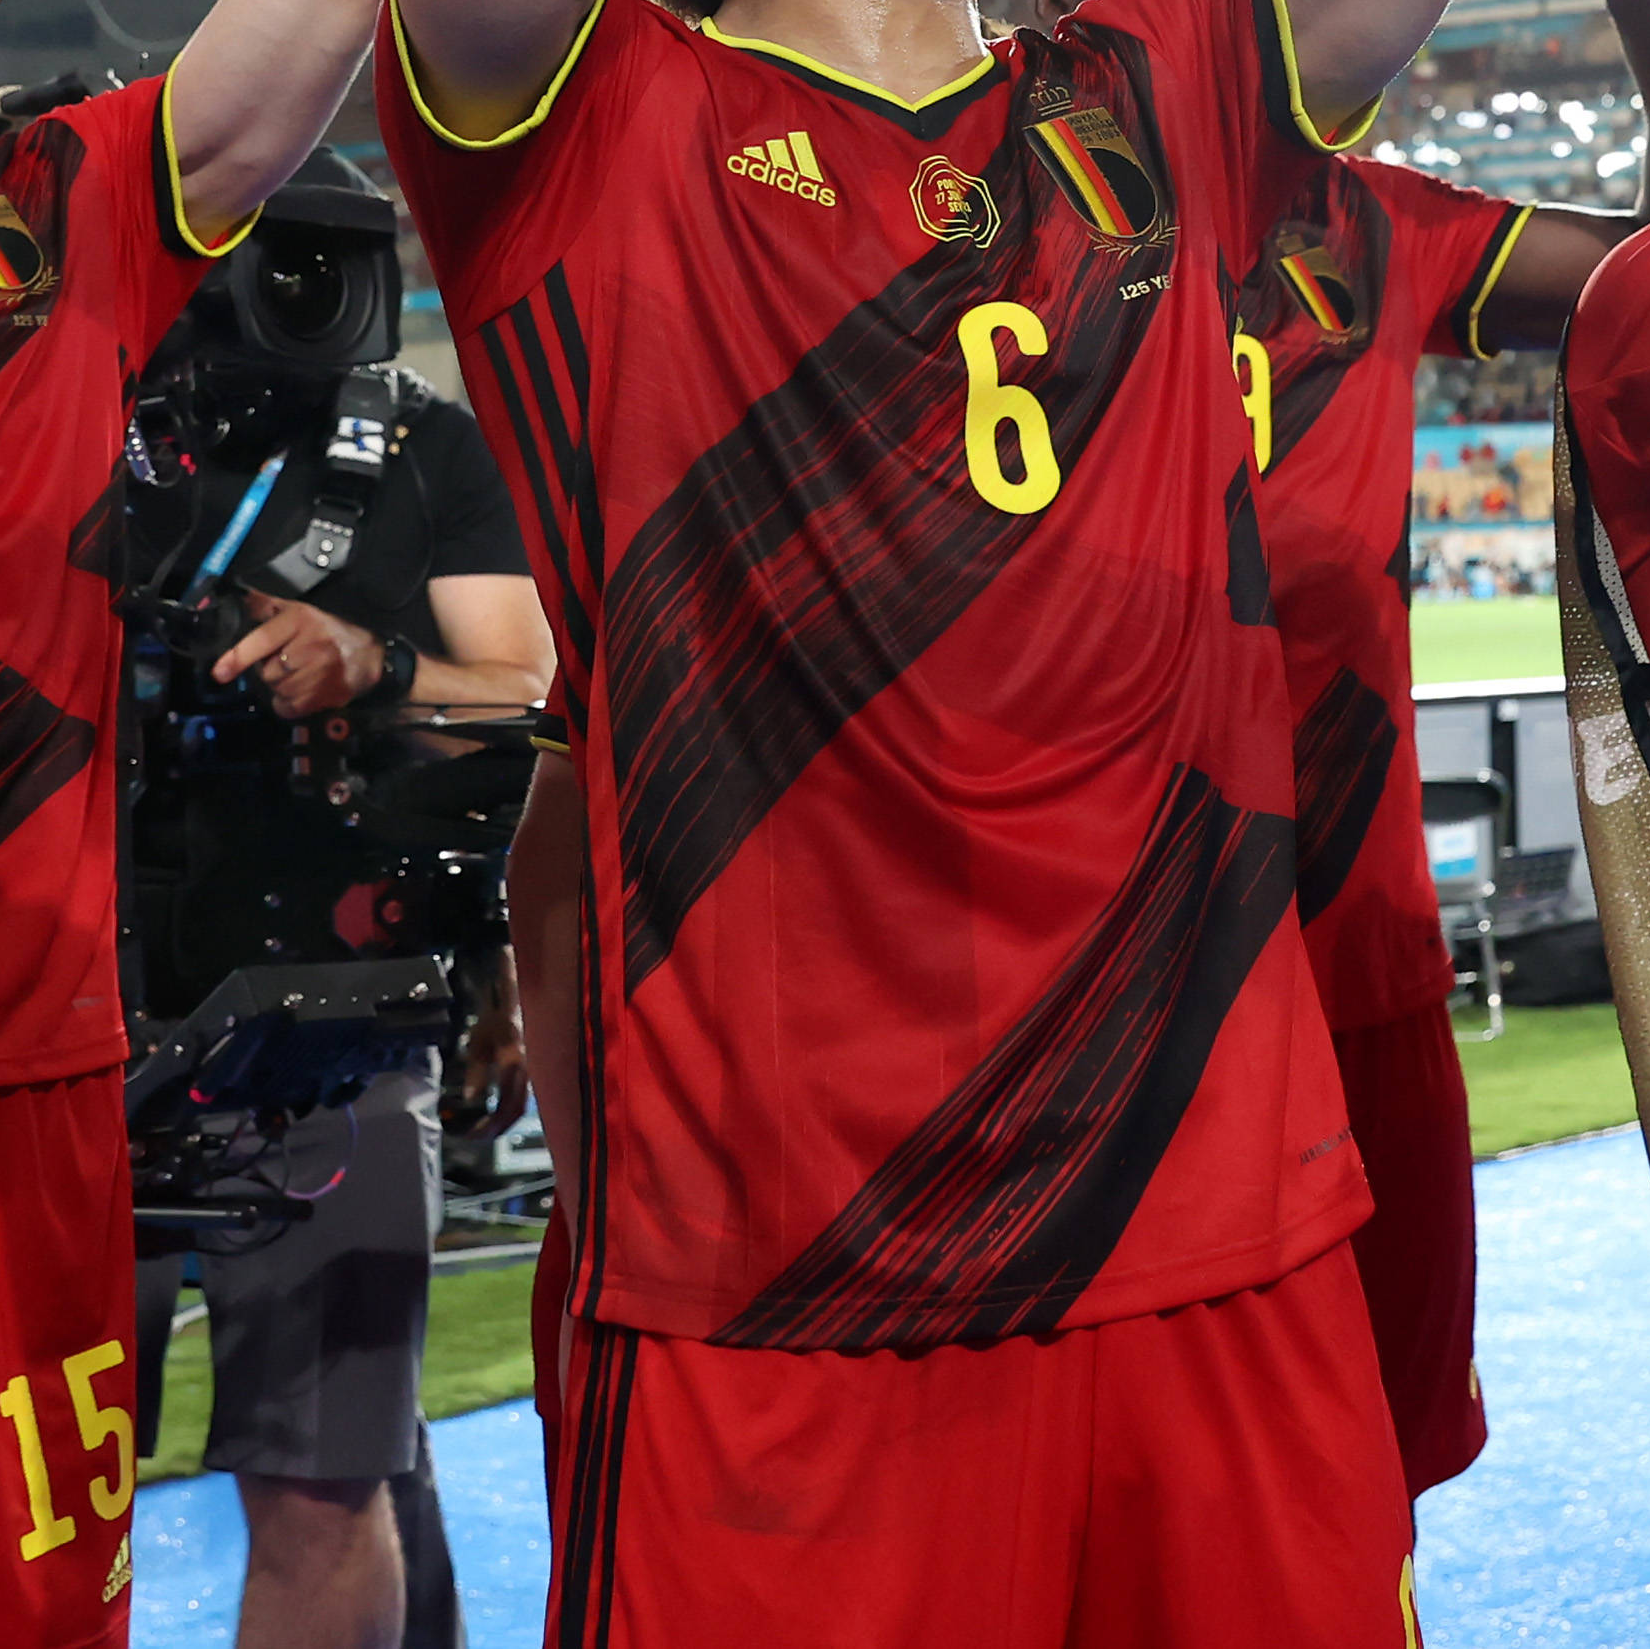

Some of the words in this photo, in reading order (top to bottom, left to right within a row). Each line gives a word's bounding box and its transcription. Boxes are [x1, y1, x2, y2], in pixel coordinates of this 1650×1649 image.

[727, 154, 836, 207] adidas
[1119, 281, 1151, 300] 125
[1150, 275, 1174, 290] YE
[957, 301, 1061, 515] 6
[1232, 333, 1272, 474] 9
